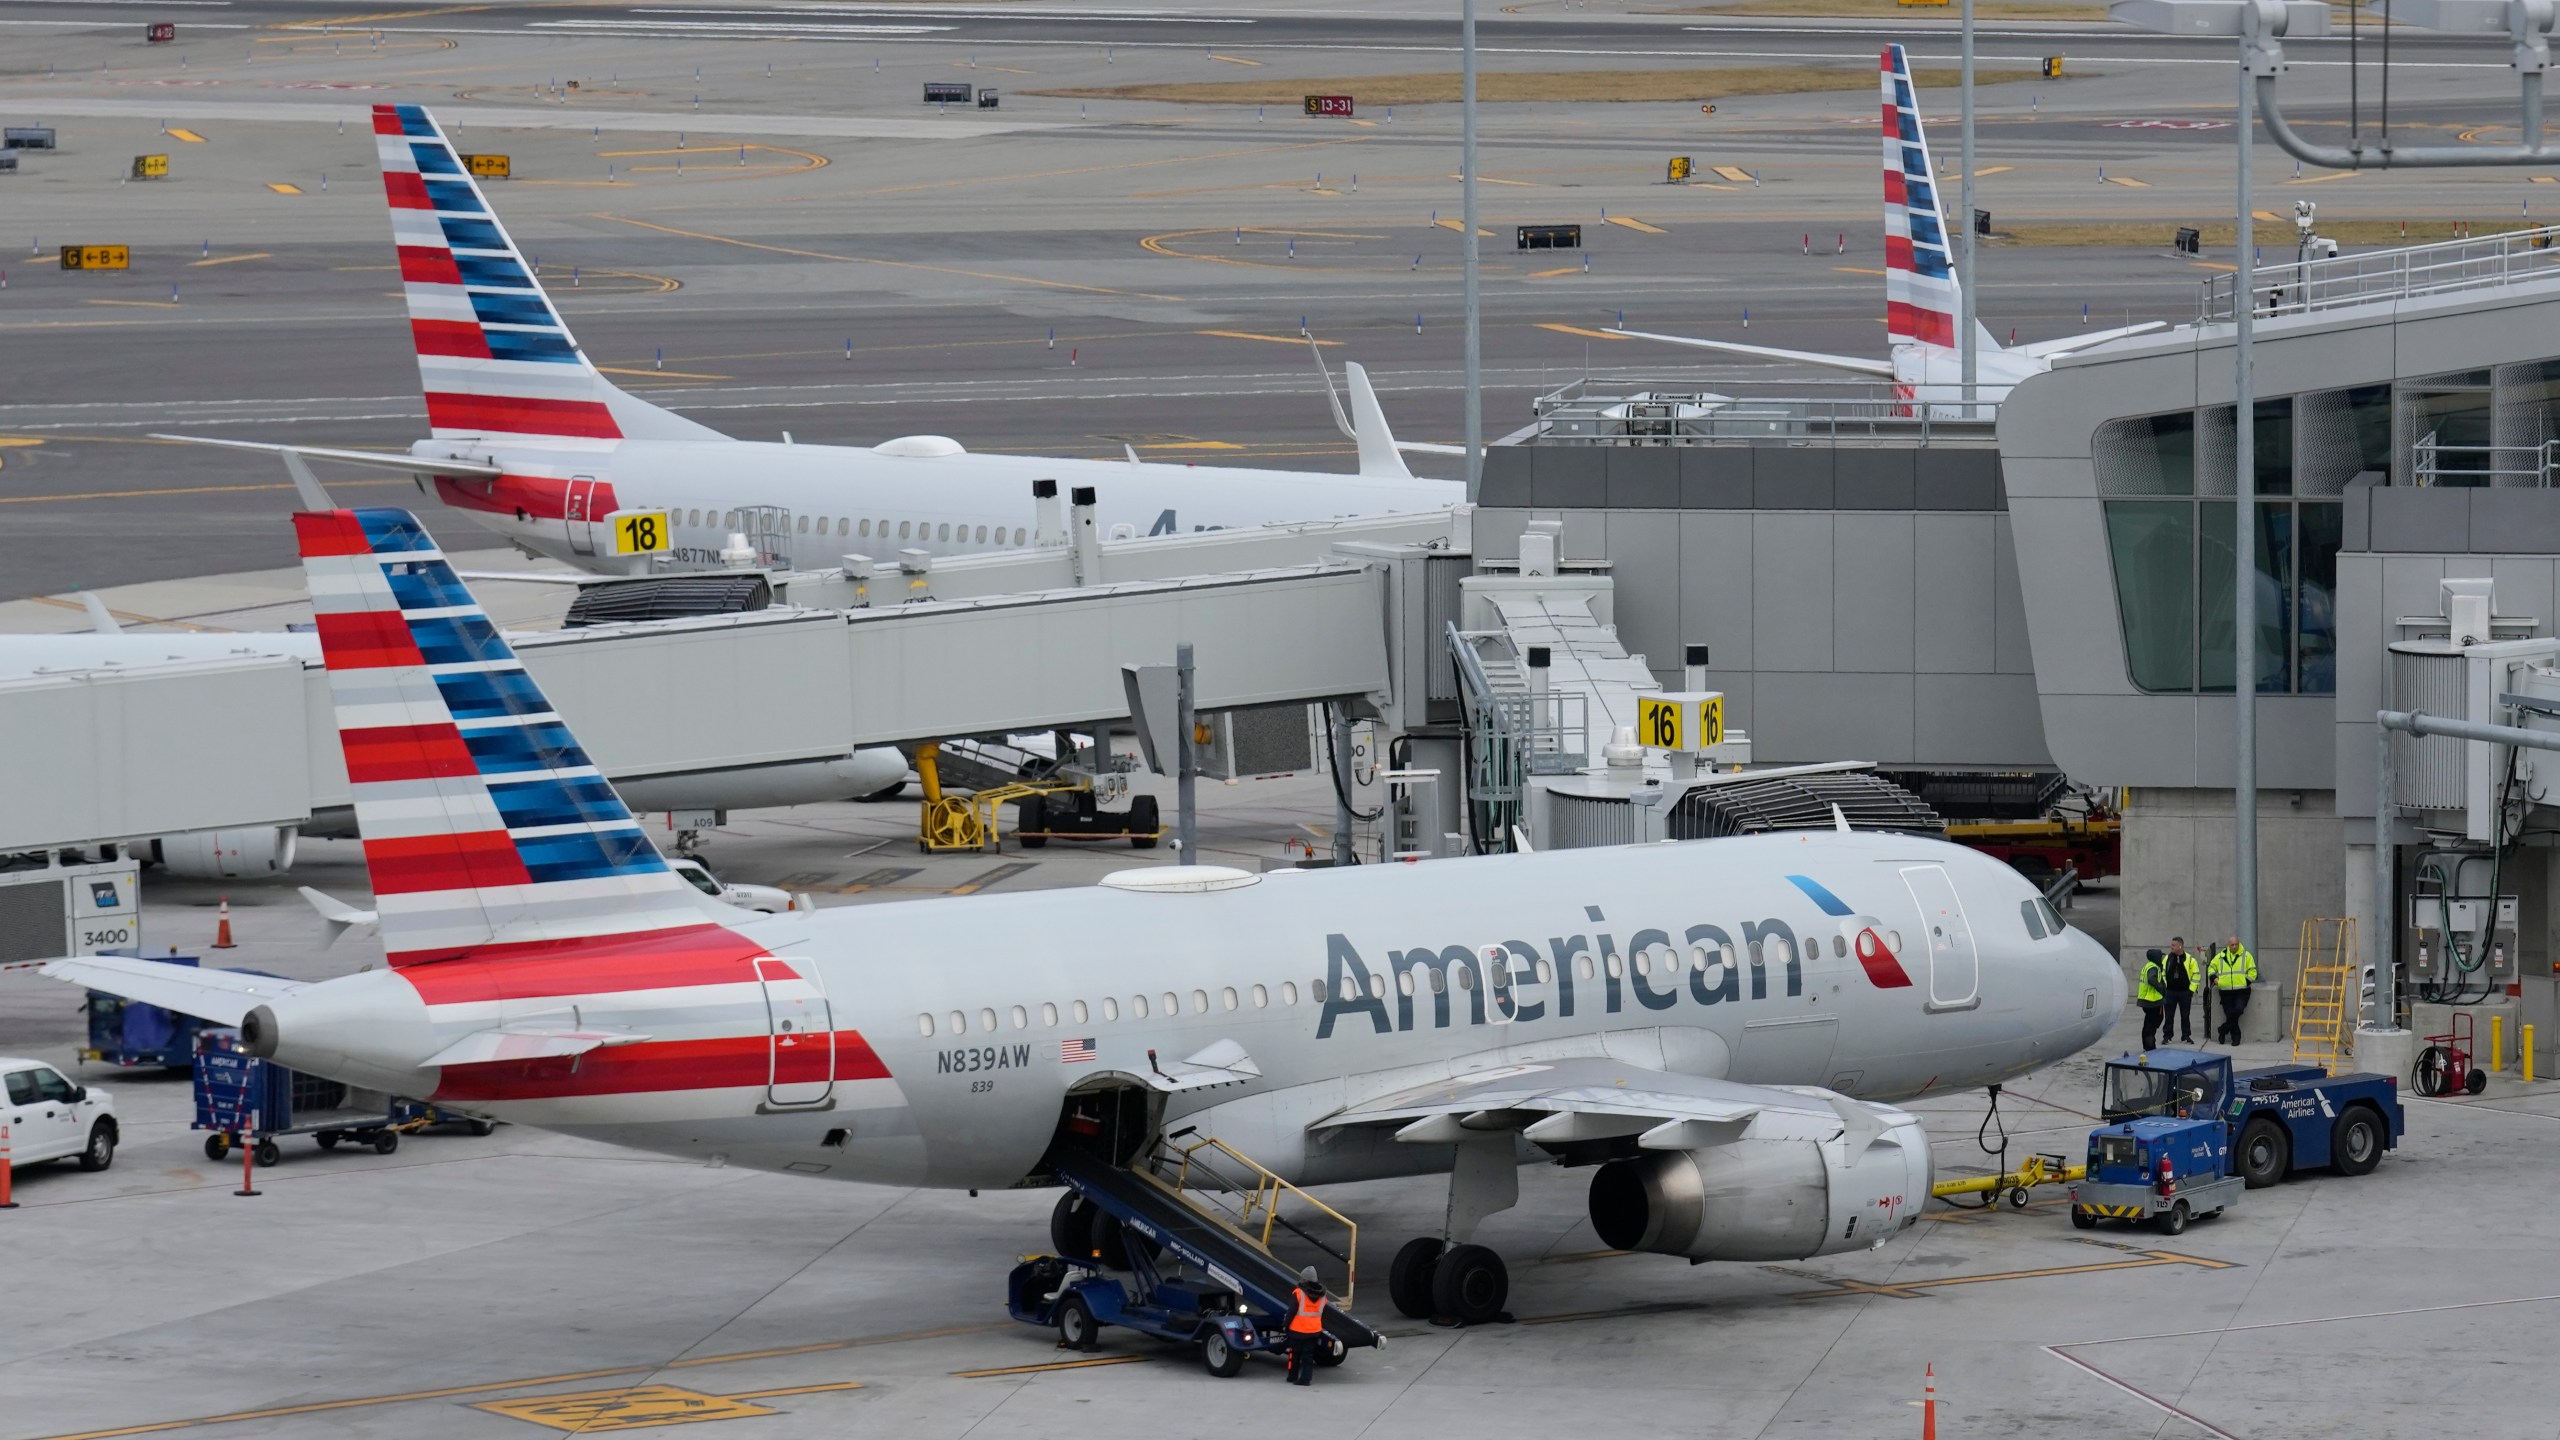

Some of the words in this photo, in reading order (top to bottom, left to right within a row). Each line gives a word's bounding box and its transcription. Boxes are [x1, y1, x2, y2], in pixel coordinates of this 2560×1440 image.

[1310, 99, 1317, 111] S
[1321, 99, 1351, 112] 13-31
[487, 159, 495, 171] P
[67, 250, 78, 265] G
[100, 250, 111, 265] B
[625, 517, 657, 552] 18
[1649, 703, 1675, 747] 16
[1704, 702, 1718, 746] 16
[694, 817, 713, 828] A09
[84, 928, 128, 946] 3400
[1315, 905, 1803, 1040] American
[938, 1044, 1031, 1074] N839AW
[971, 1080, 994, 1093] 839
[2281, 1094, 2315, 1110] American
[2287, 1106, 2315, 1119] Airlines
[1129, 1216, 1157, 1240] AMERICAN
